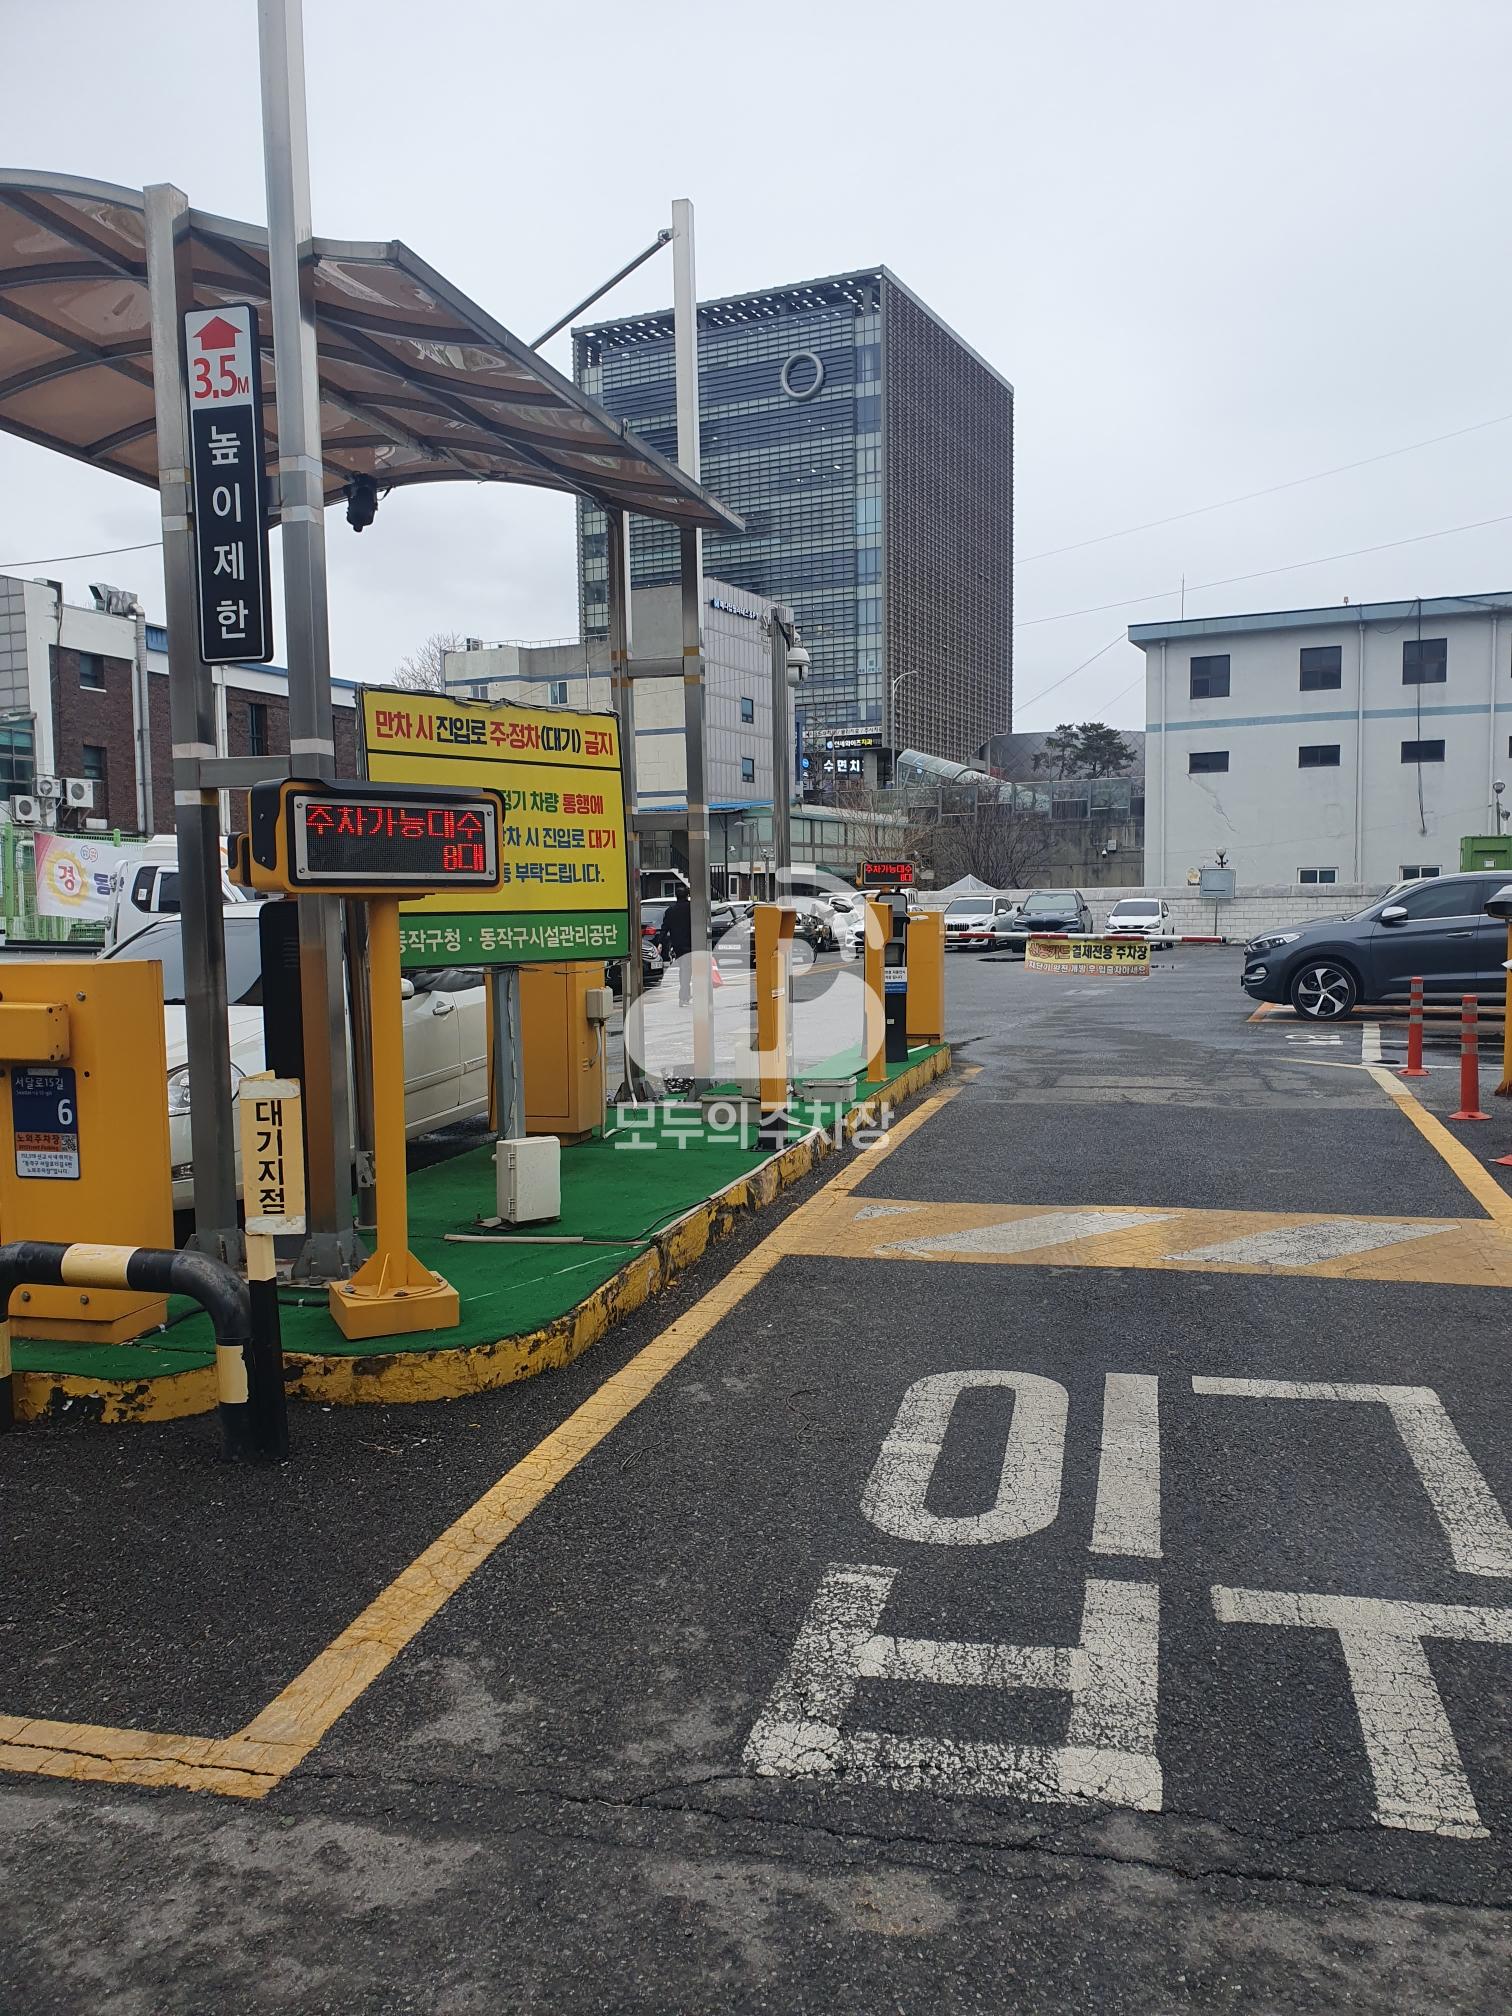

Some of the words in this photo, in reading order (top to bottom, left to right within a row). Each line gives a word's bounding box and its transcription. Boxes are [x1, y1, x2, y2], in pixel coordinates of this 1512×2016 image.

[193, 354, 249, 399] 3.5M
[208, 426, 249, 639] 높이제한
[375, 710, 412, 738] 만차
[415, 714, 433, 741] 시
[436, 716, 488, 745] 진입로
[584, 730, 614, 756] 금지
[824, 759, 864, 772] 수면치
[530, 791, 559, 812] 차량
[563, 793, 604, 814] 통행에
[306, 805, 484, 839] 주차가능대수
[503, 826, 521, 846] 차
[525, 827, 539, 847] 시
[543, 827, 585, 848] 진입로
[588, 829, 616, 849] 대기
[443, 843, 484, 871] 8대
[58, 865, 76, 891] 경
[515, 863, 605, 884] 부탁드립니다.
[480, 924, 617, 951] 동작구시설관리공단
[1029, 943, 1070, 959] 신용카드
[1072, 945, 1113, 960] 결제전용
[1116, 945, 1148, 961] 주차장
[15, 1077, 64, 1090] 서달로15길
[57, 1098, 73, 1125] 6
